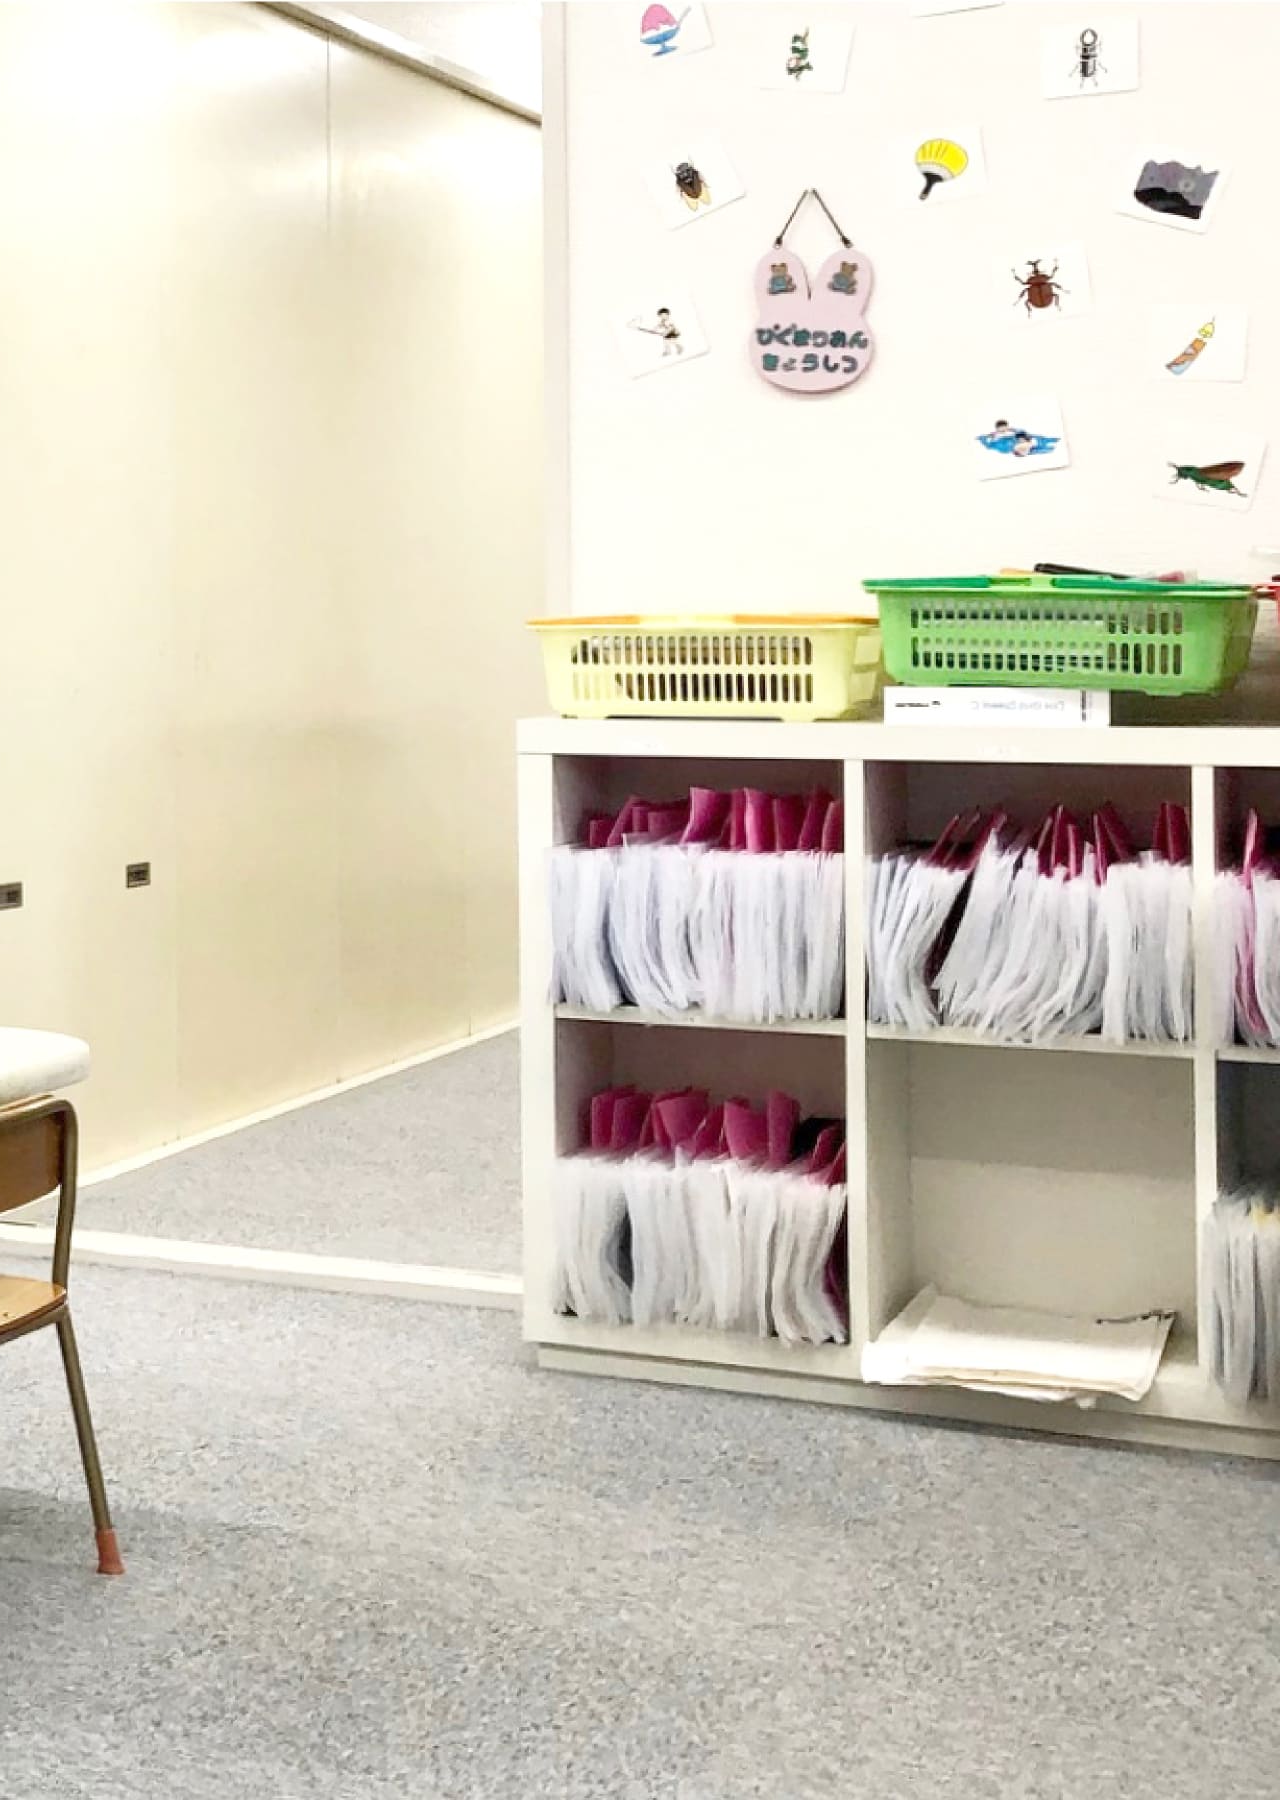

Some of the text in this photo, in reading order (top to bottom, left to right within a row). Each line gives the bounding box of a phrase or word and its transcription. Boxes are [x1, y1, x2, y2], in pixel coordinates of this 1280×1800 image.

[761, 352, 858, 373] きょうしつ
